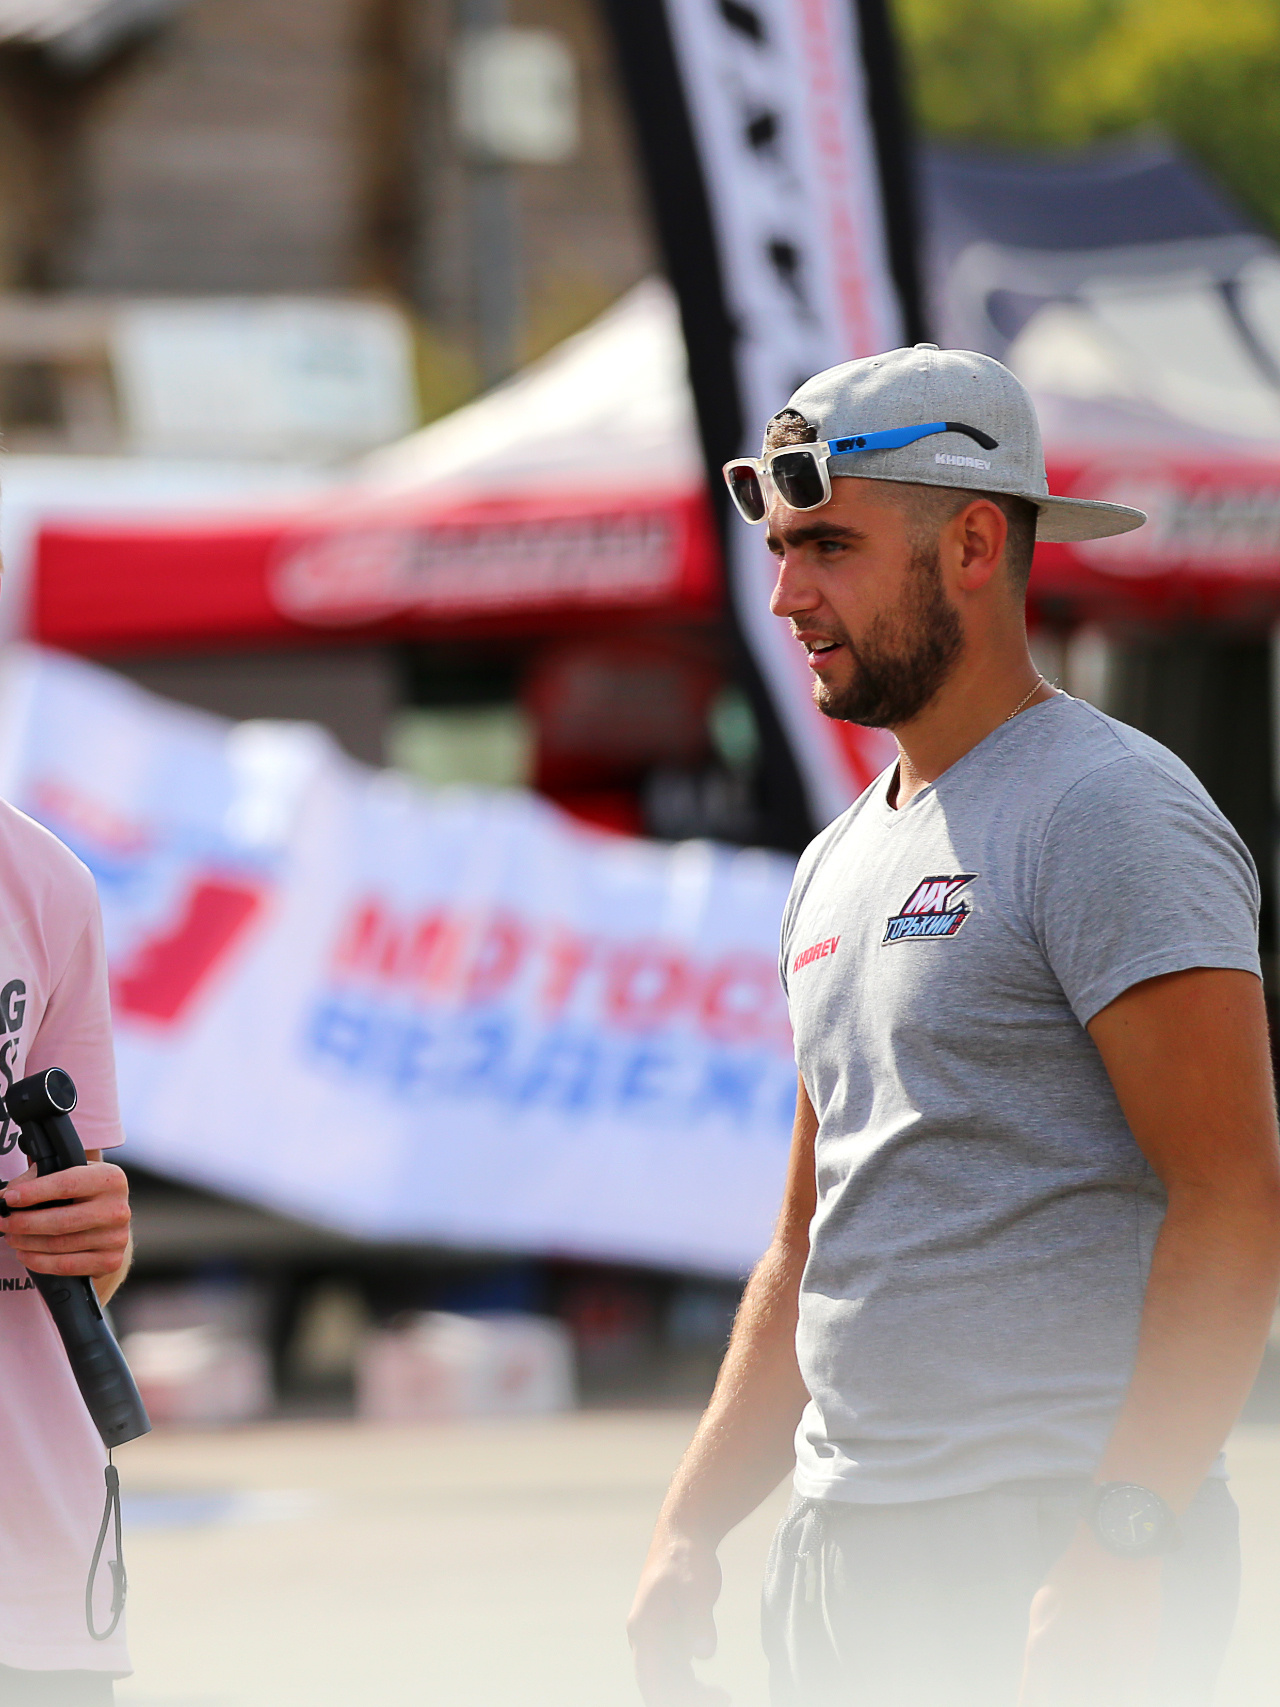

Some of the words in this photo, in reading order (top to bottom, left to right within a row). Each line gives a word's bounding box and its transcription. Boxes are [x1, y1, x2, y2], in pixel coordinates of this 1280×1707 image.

[935, 453, 991, 471] KHOREV
[902, 880, 966, 916] MX
[323, 885, 796, 1056] МОТОС
[792, 935, 841, 974] KHOREV
